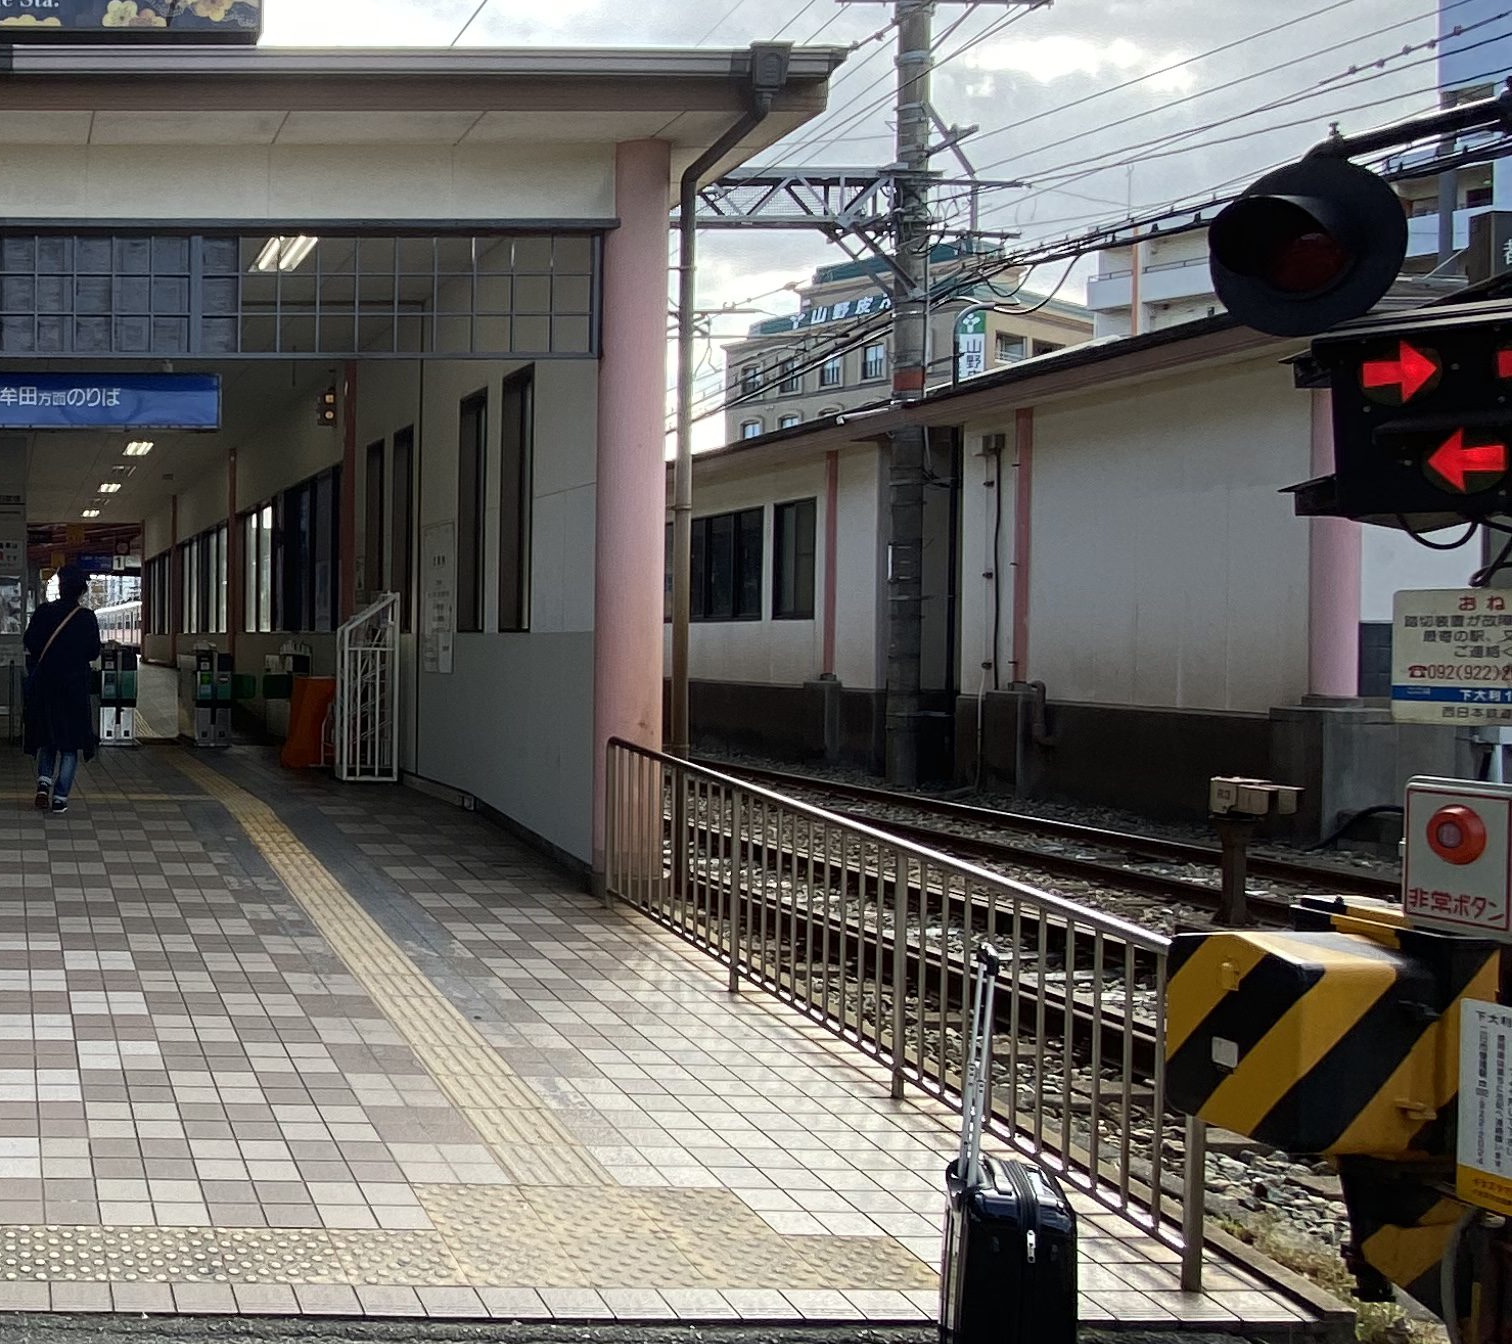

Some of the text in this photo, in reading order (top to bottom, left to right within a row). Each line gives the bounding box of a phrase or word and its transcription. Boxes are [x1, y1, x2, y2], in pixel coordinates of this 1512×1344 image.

[1408, 887, 1505, 921] 非常ボタン
